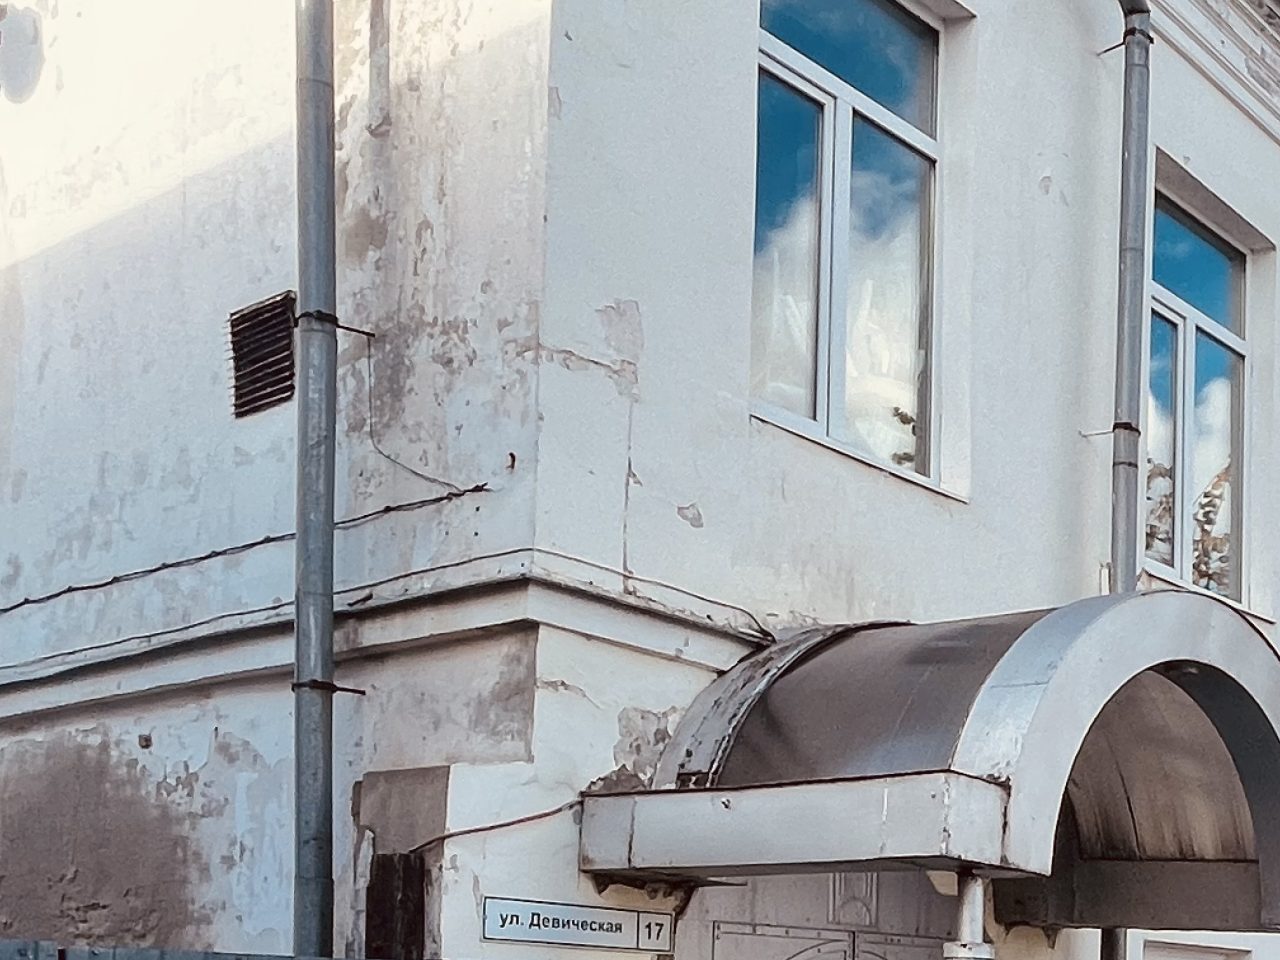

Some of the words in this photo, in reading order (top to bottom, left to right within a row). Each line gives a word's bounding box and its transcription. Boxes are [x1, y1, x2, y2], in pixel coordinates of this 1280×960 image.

[500, 913, 524, 928] ул.
[529, 912, 623, 933] Девическая
[645, 922, 664, 941] 17
